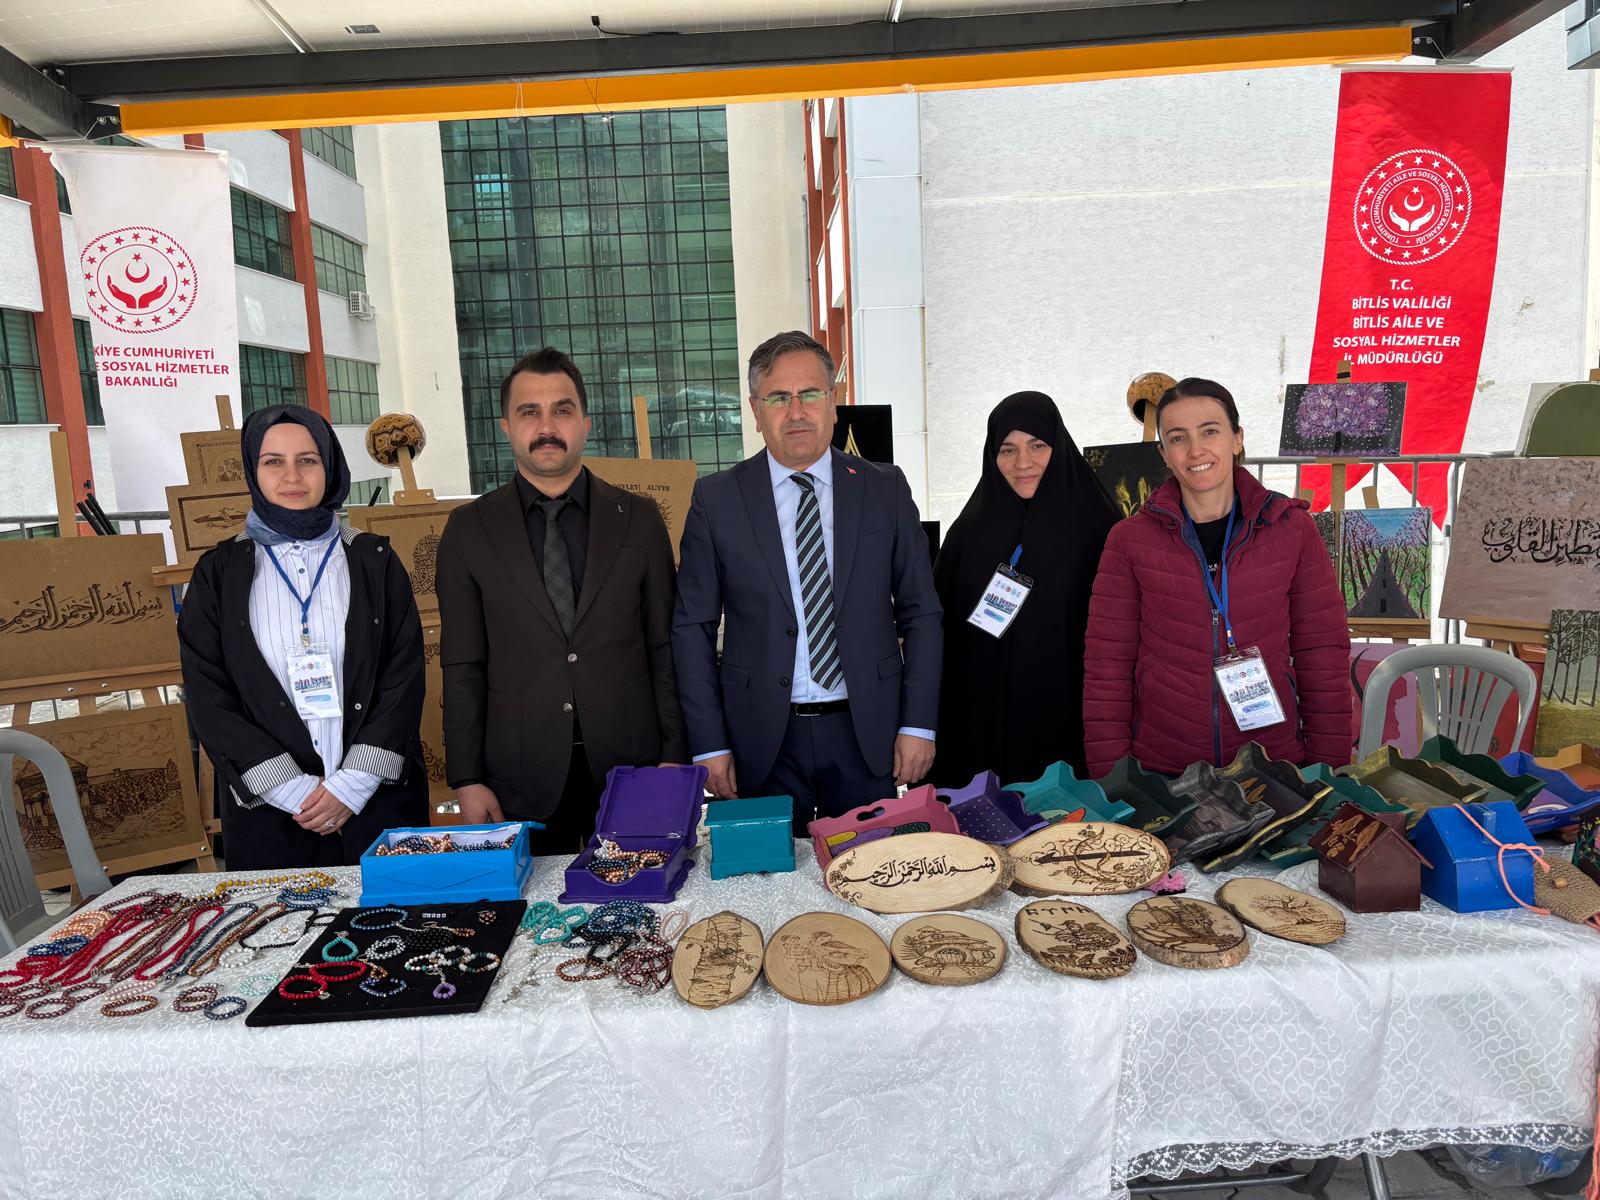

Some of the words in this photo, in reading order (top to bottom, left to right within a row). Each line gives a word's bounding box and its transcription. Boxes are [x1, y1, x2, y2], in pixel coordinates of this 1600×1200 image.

[1418, 171, 1440, 185] SOSYAL
[1389, 279, 1414, 290] T.C.
[1352, 295, 1389, 309] BİTLİS
[1392, 295, 1452, 309] VALİLİĞİ
[1353, 314, 1389, 329] BİTLİS
[1392, 314, 1423, 328] AİLE
[1426, 317, 1444, 328] VE
[1333, 335, 1378, 348] SOSYAL
[1381, 333, 1461, 347] HİZMETLER
[123, 346, 215, 360] CUMHURİYETİ
[1357, 351, 1443, 365] MÜDÜRLÜĞÜ
[102, 361, 152, 372] SOSYAL
[155, 361, 230, 375] HİZMETLER
[105, 376, 178, 388] BAKANLIĞI
